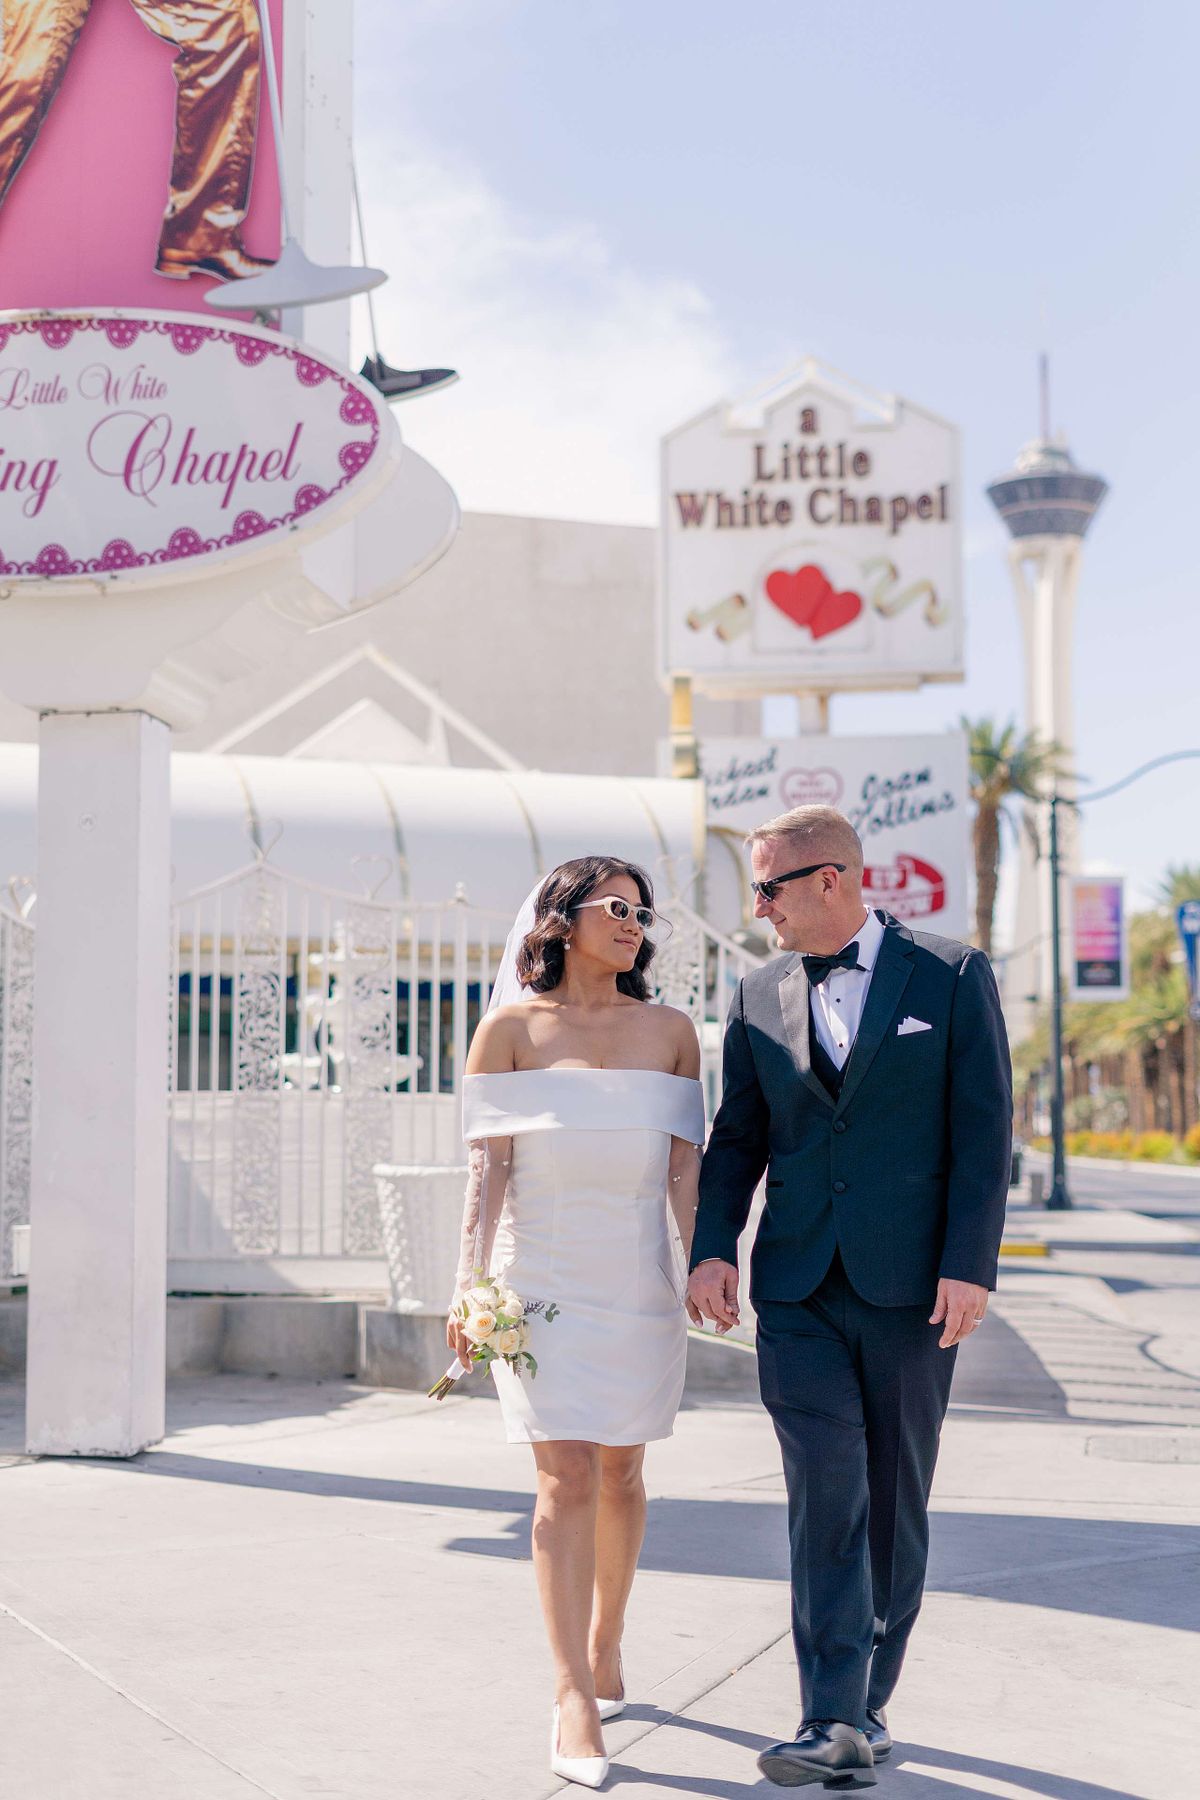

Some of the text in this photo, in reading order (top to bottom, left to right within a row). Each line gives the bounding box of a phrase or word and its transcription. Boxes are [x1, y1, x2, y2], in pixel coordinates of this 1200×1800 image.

[0, 362, 168, 411] Little White
[799, 406, 818, 434] a
[87, 409, 304, 509] Chapel
[754, 443, 872, 483] Little
[675, 483, 950, 537] White Chapel
